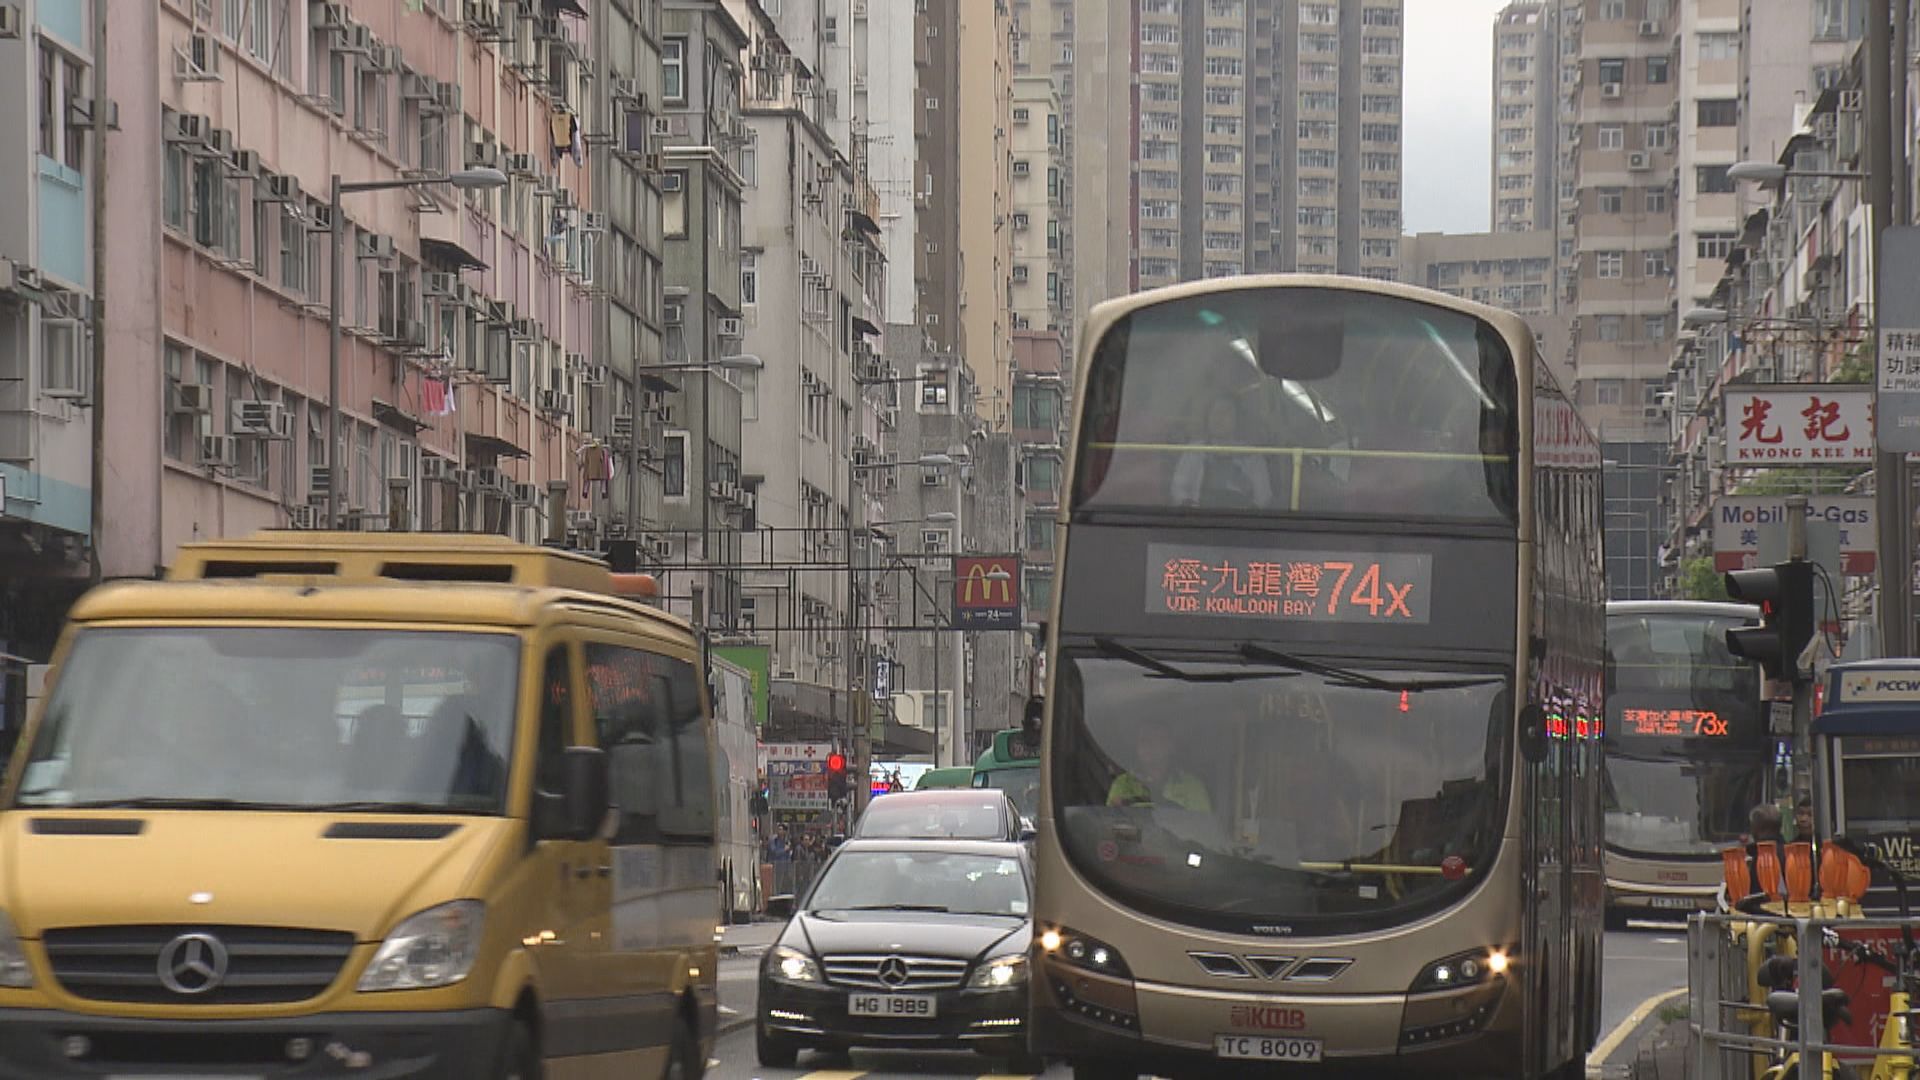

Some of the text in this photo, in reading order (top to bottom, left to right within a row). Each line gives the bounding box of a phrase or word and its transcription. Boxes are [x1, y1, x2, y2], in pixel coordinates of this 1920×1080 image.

[1739, 396, 1876, 443] 光記
[1739, 448, 1802, 458] KWONG
[1812, 448, 1845, 458] KEE
[1723, 506, 1868, 523] Mobil P-Gas
[1283, 600, 1316, 616] BAY
[1876, 680, 1920, 691] PCCW
[1253, 925, 1293, 934] VOLVO
[856, 998, 928, 1014] HG 1989
[1224, 1038, 1316, 1058] TC 8009
